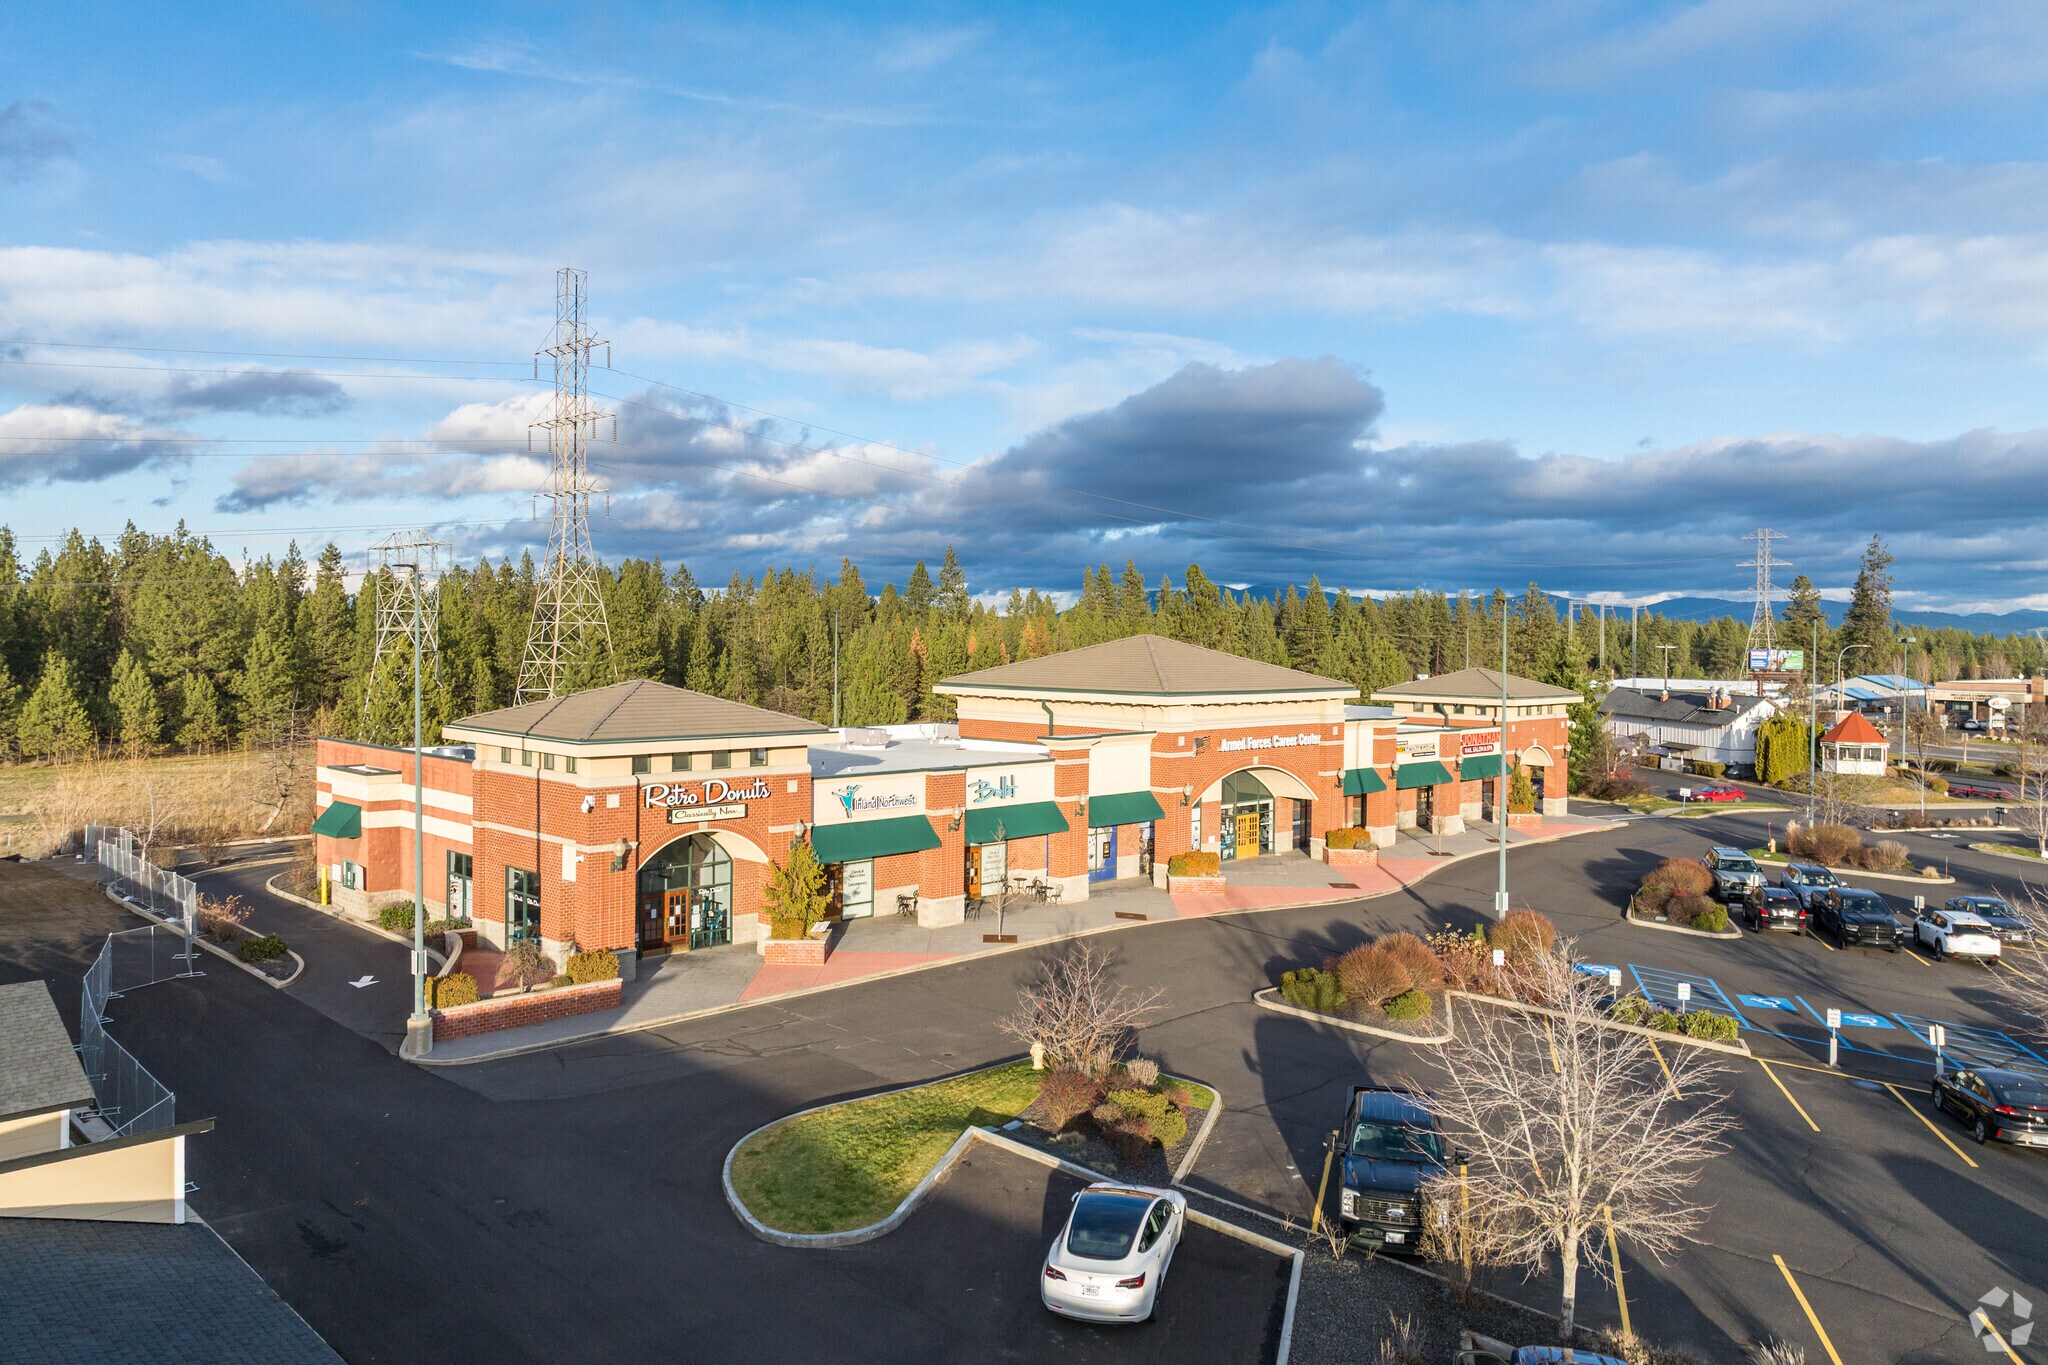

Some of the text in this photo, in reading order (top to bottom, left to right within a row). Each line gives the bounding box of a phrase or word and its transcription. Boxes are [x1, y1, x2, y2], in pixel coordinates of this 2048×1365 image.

[1220, 733, 1321, 752] Armed Forces Career Center
[1461, 732, 1500, 745] JONATHAN
[641, 777, 772, 809] Retro Donuts
[854, 794, 917, 810] Inland Northwest
[675, 808, 717, 819] Classically
